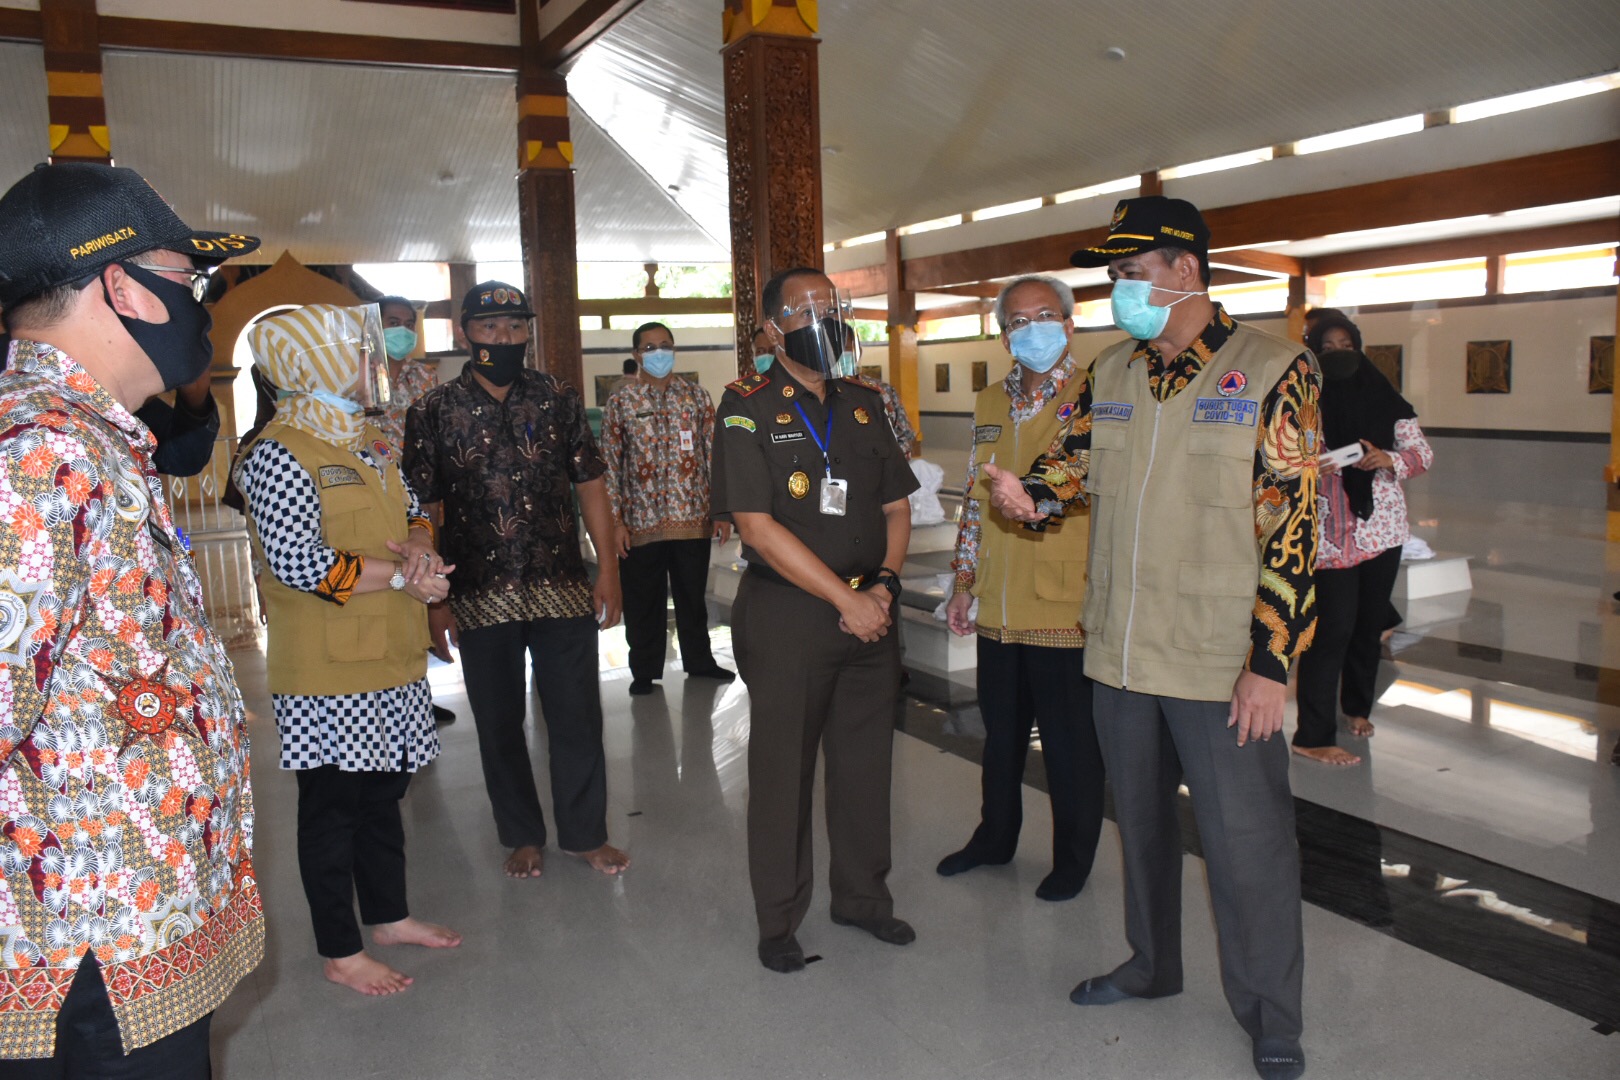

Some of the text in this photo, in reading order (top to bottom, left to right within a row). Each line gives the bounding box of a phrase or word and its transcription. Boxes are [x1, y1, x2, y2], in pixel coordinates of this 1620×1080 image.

[69, 226, 137, 260] PARIWISATA
[1227, 401, 1255, 414] TUGAS
[1204, 410, 1245, 423] COVID-19
